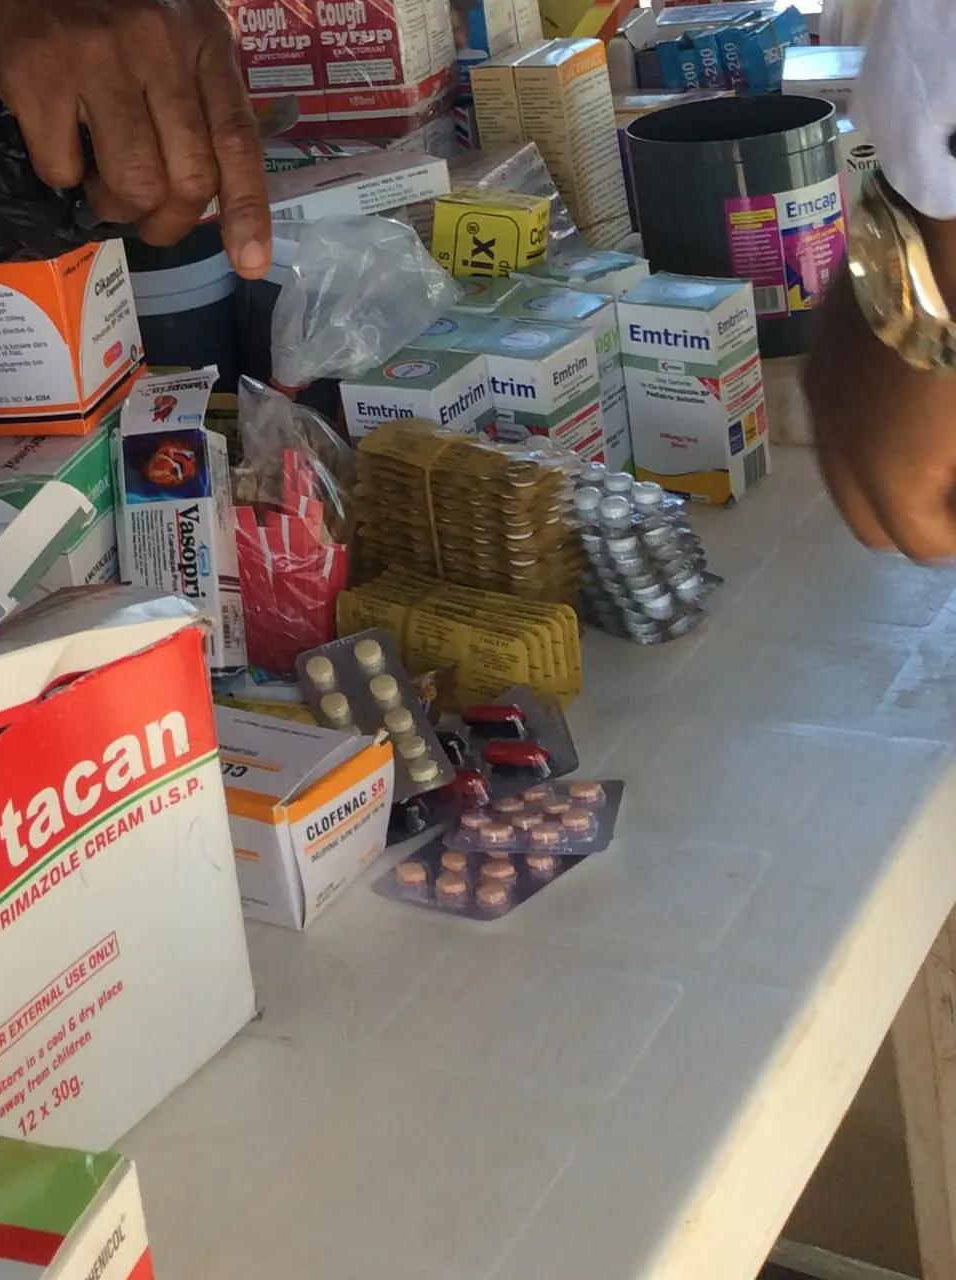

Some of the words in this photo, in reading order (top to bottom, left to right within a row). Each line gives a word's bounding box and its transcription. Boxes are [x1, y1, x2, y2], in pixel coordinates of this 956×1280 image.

[238, 0, 287, 36] Cough
[786, 190, 837, 219] Emcap
[629, 324, 711, 351] Emtrim
[717, 308, 749, 333] Emtrim
[552, 354, 589, 387] Emtrim
[357, 401, 415, 419] Emtrim
[439, 380, 487, 426] Emtrim
[177, 504, 206, 598] Vasopri
[84, 806, 145, 859] CREAM
[148, 776, 205, 817] U.S.P.
[305, 791, 368, 841] CLOFENAC
[370, 778, 385, 797] SR
[7, 985, 64, 1045] EXTERNAL
[64, 968, 89, 994] USE
[88, 939, 117, 973] ONLY
[25, 1054, 38, 1072] in
[38, 1048, 47, 1059] a
[46, 1027, 69, 1054] cool
[78, 1000, 98, 1028] dry
[96, 980, 125, 1012] place
[26, 1069, 53, 1095] from
[51, 1030, 93, 1072] children
[17, 1107, 37, 1137] 12
[37, 1099, 52, 1121] x
[51, 1075, 85, 1113] 30g.
